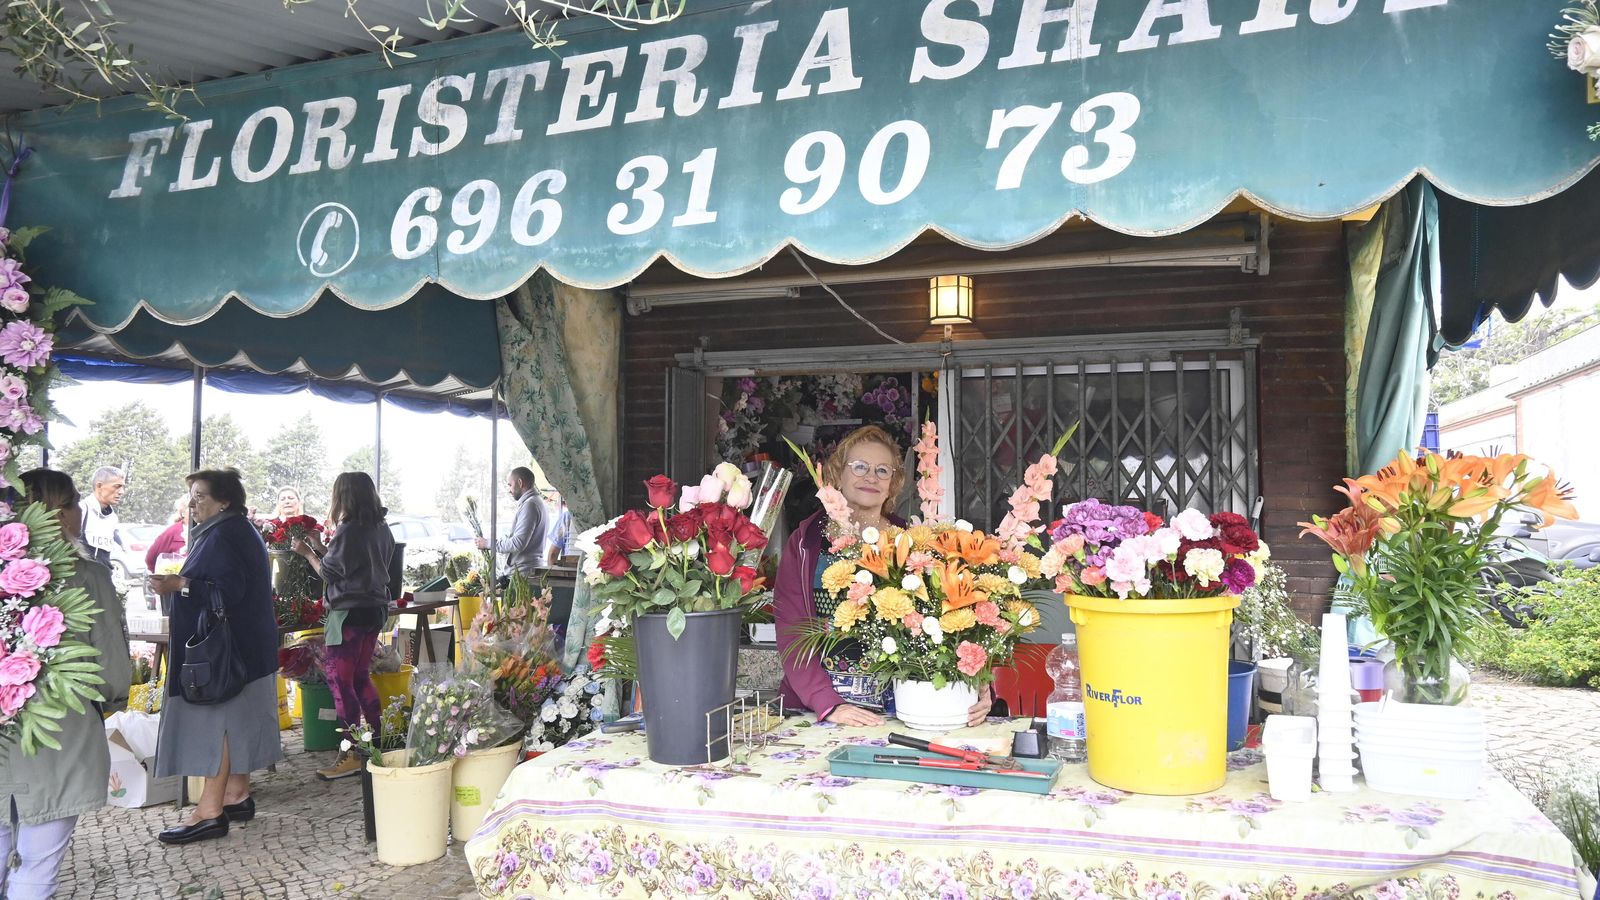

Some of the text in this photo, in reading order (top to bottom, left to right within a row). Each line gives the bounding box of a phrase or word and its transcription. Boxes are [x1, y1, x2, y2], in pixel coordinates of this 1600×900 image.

[390, 92, 1141, 260] 696 31 90 73
